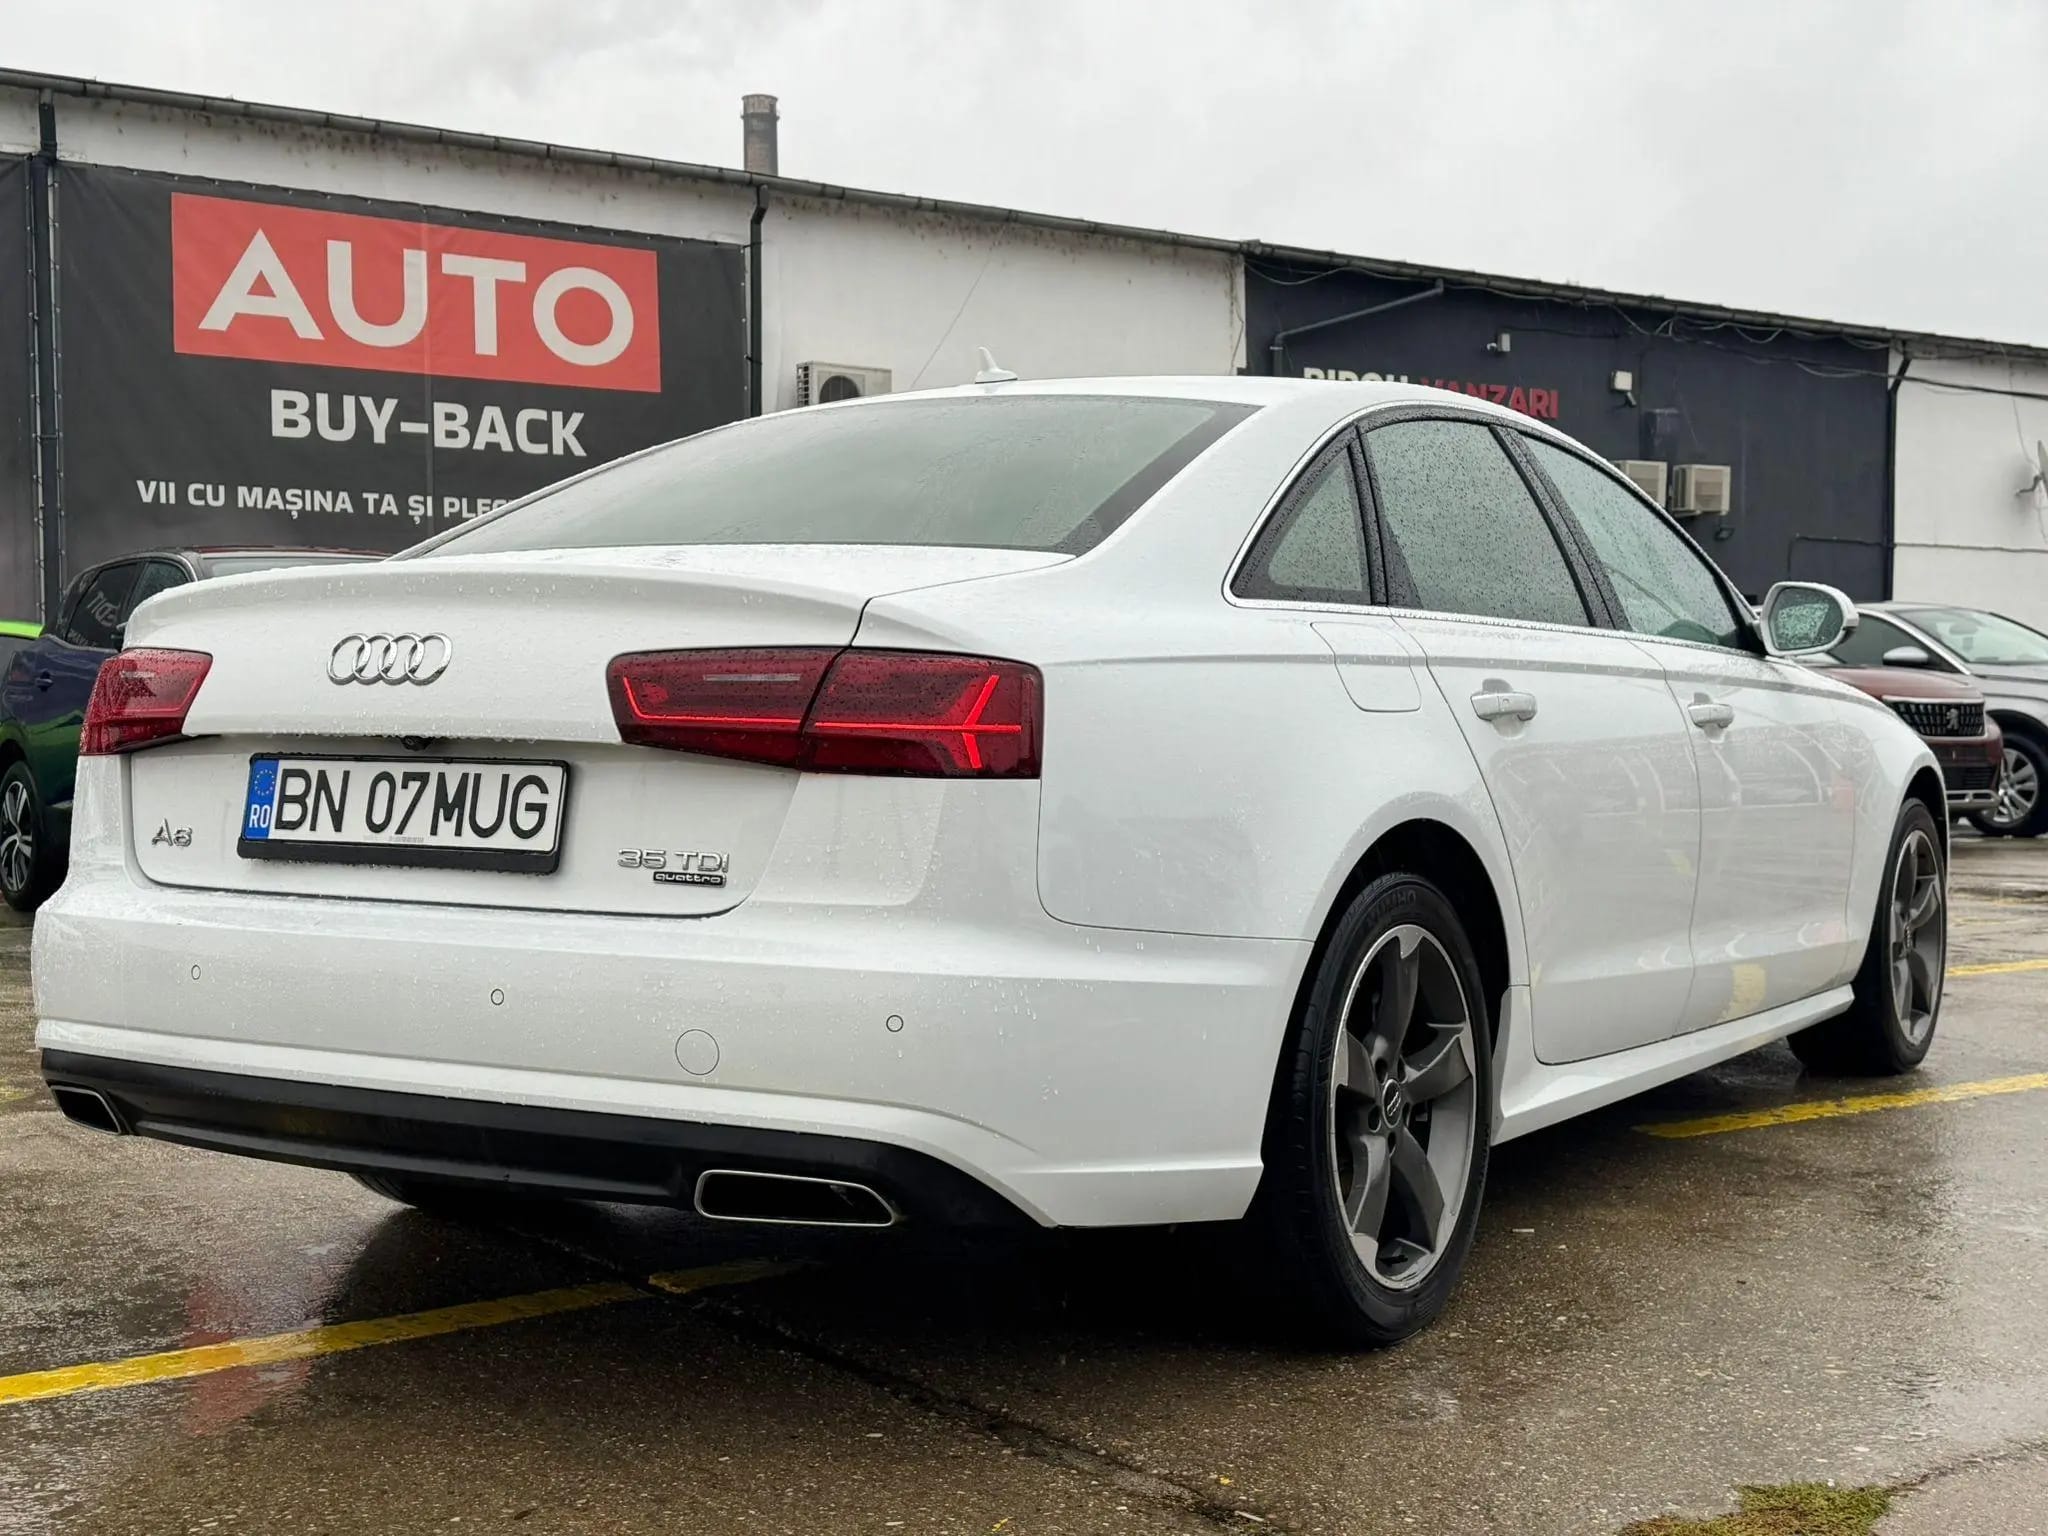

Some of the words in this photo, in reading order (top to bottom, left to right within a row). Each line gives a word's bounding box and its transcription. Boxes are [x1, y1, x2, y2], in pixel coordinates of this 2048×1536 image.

[198, 228, 634, 367] AUTO
[271, 389, 587, 457] BUY-BACK
[136, 480, 176, 505] VII
[187, 483, 225, 507] CU
[237, 486, 354, 520] MAȘINA
[363, 492, 399, 516] TA
[408, 495, 433, 525] ȘI
[249, 804, 270, 829] RO
[275, 768, 351, 833] BN
[151, 817, 193, 848] A6
[617, 848, 667, 870] 35
[674, 850, 730, 874] TDI
[654, 872, 723, 885] quattro
